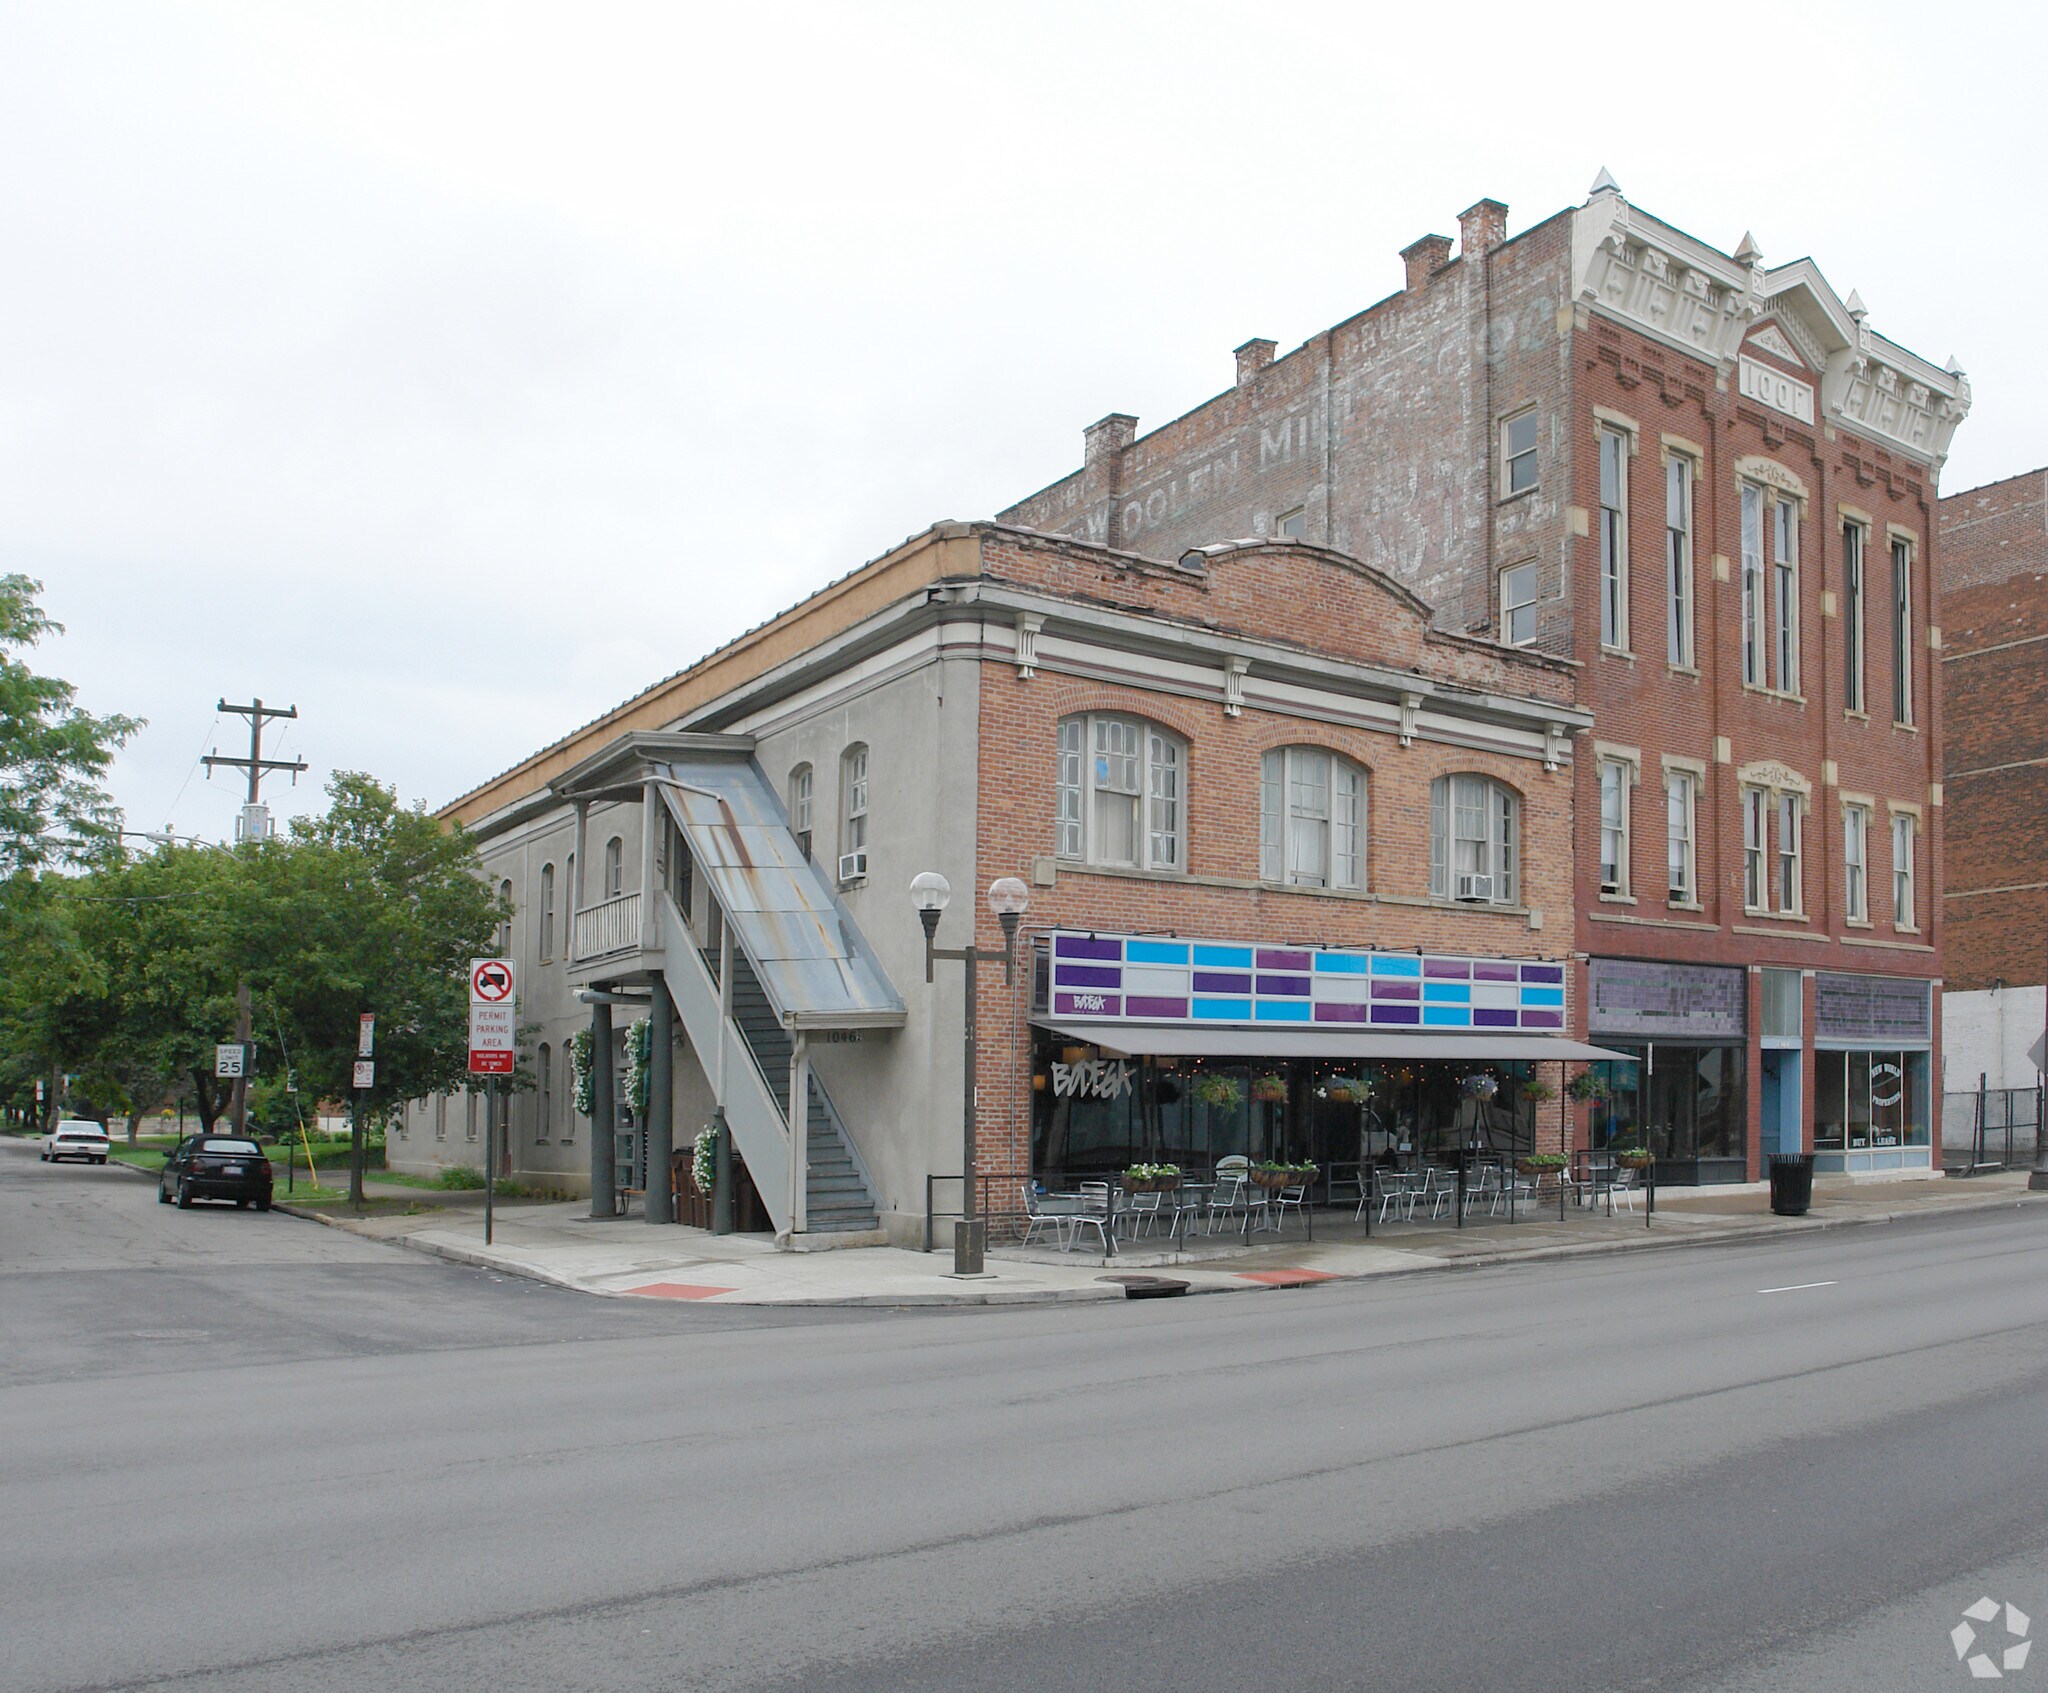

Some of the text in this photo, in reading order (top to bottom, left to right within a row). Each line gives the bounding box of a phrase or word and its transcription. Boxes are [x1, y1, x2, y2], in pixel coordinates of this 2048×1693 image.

[1073, 994, 1107, 1011] BODEGA
[478, 1011, 507, 1021] PERMIT
[476, 1024, 509, 1034] PARKING
[481, 1038, 503, 1047] AREA
[219, 1061, 241, 1074] 25
[1050, 1059, 1137, 1100] BODEGA
[1852, 1137, 1867, 1147] BUY
